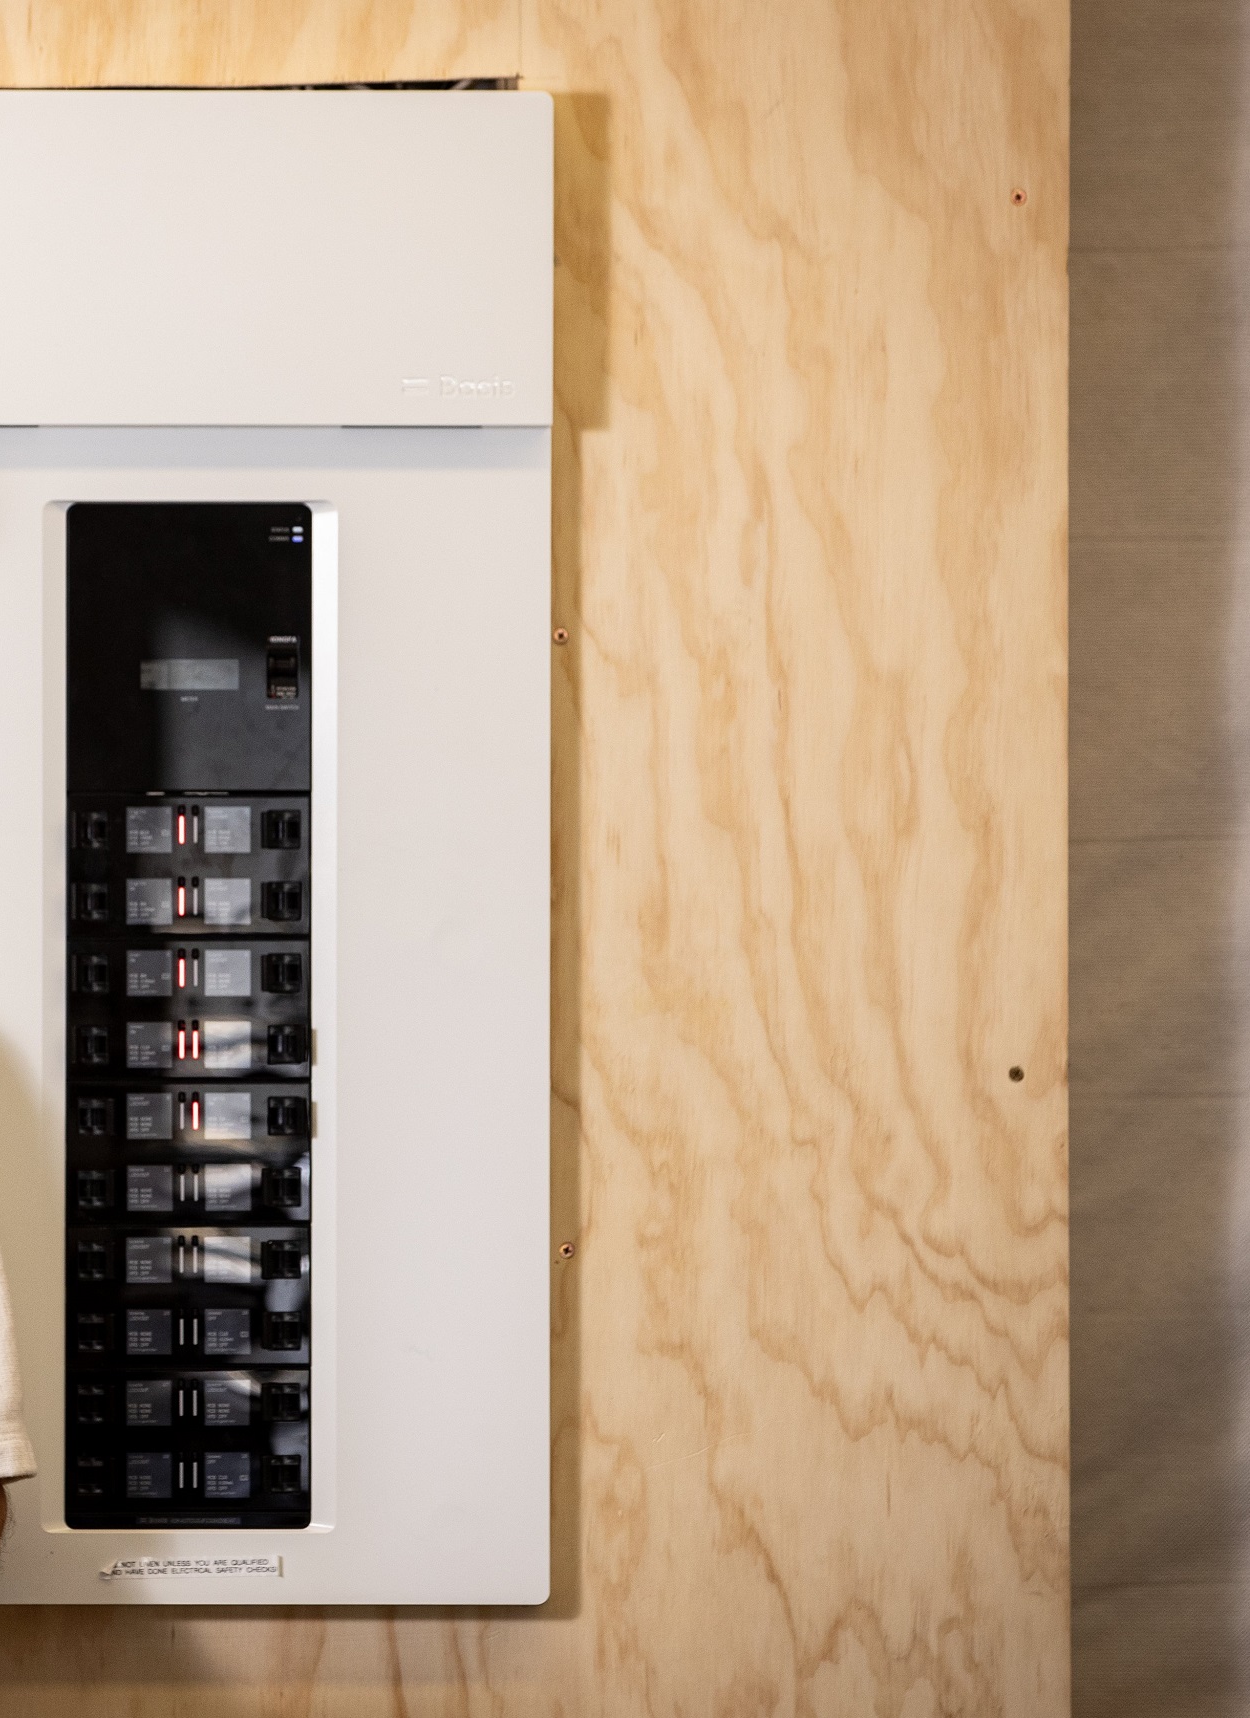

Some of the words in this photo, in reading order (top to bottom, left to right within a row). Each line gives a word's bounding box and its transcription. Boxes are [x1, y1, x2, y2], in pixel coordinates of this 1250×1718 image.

[194, 1559, 210, 1567] YOU
[230, 1558, 270, 1566] QUALIFIED
[125, 1568, 145, 1576] HAVE
[215, 1566, 243, 1574] SAFETY
